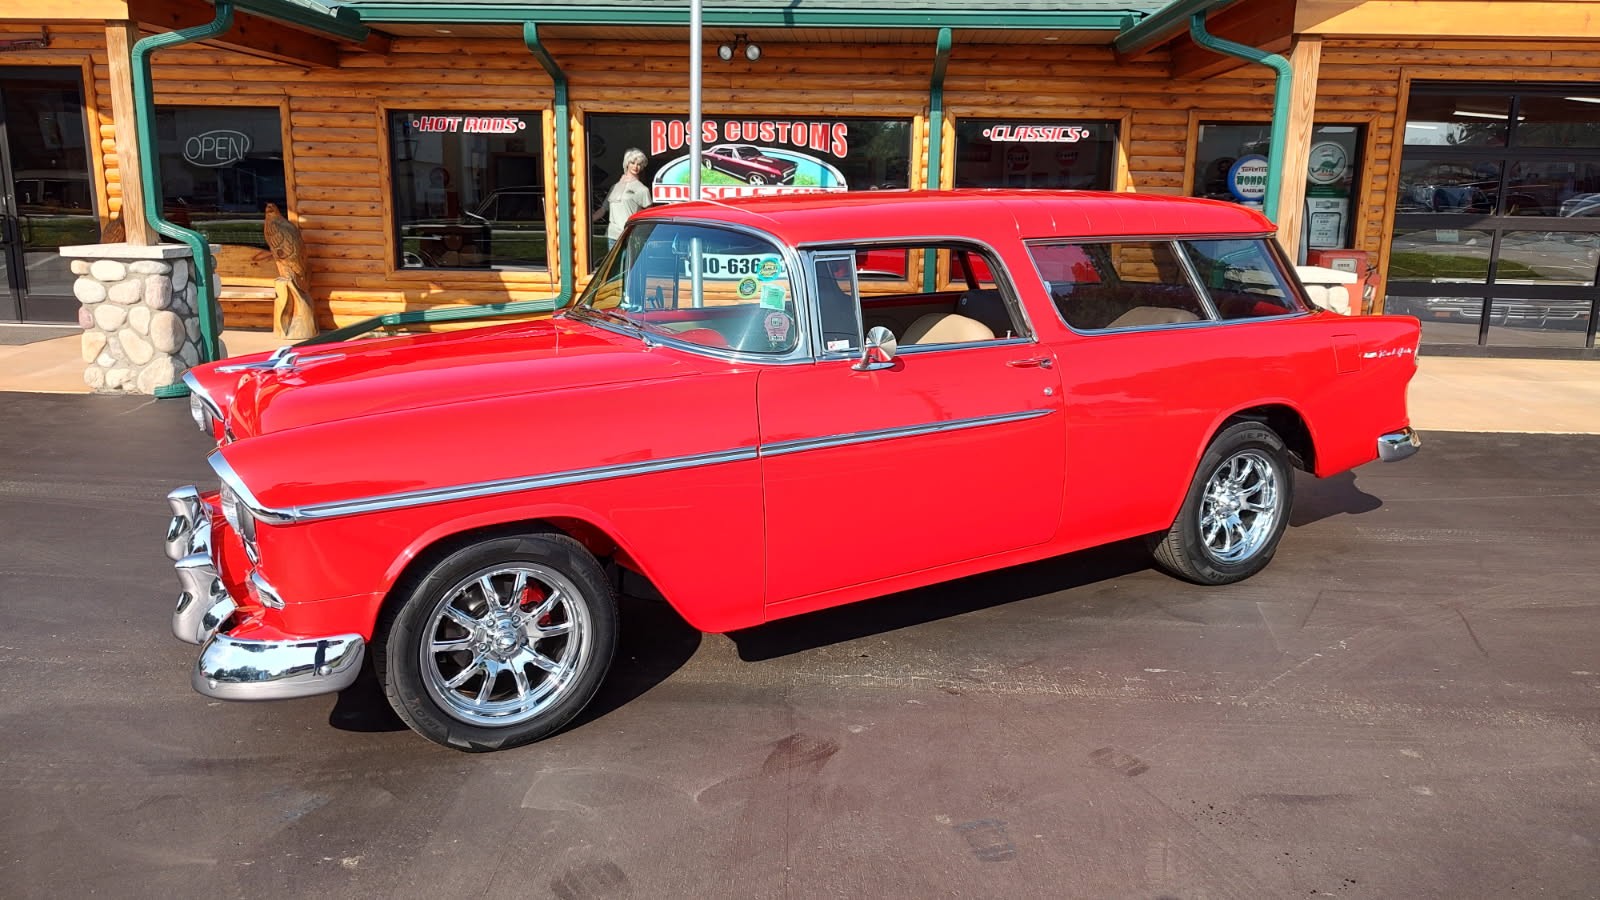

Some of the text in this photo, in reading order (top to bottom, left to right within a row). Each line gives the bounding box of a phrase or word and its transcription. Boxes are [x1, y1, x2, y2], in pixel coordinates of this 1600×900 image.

[419, 116, 518, 133] HOT RODS
[724, 120, 848, 158] CUSTOMS
[990, 125, 1082, 142] CLASSICS
[185, 136, 244, 160] OPEN
[1236, 175, 1267, 185] WONDE
